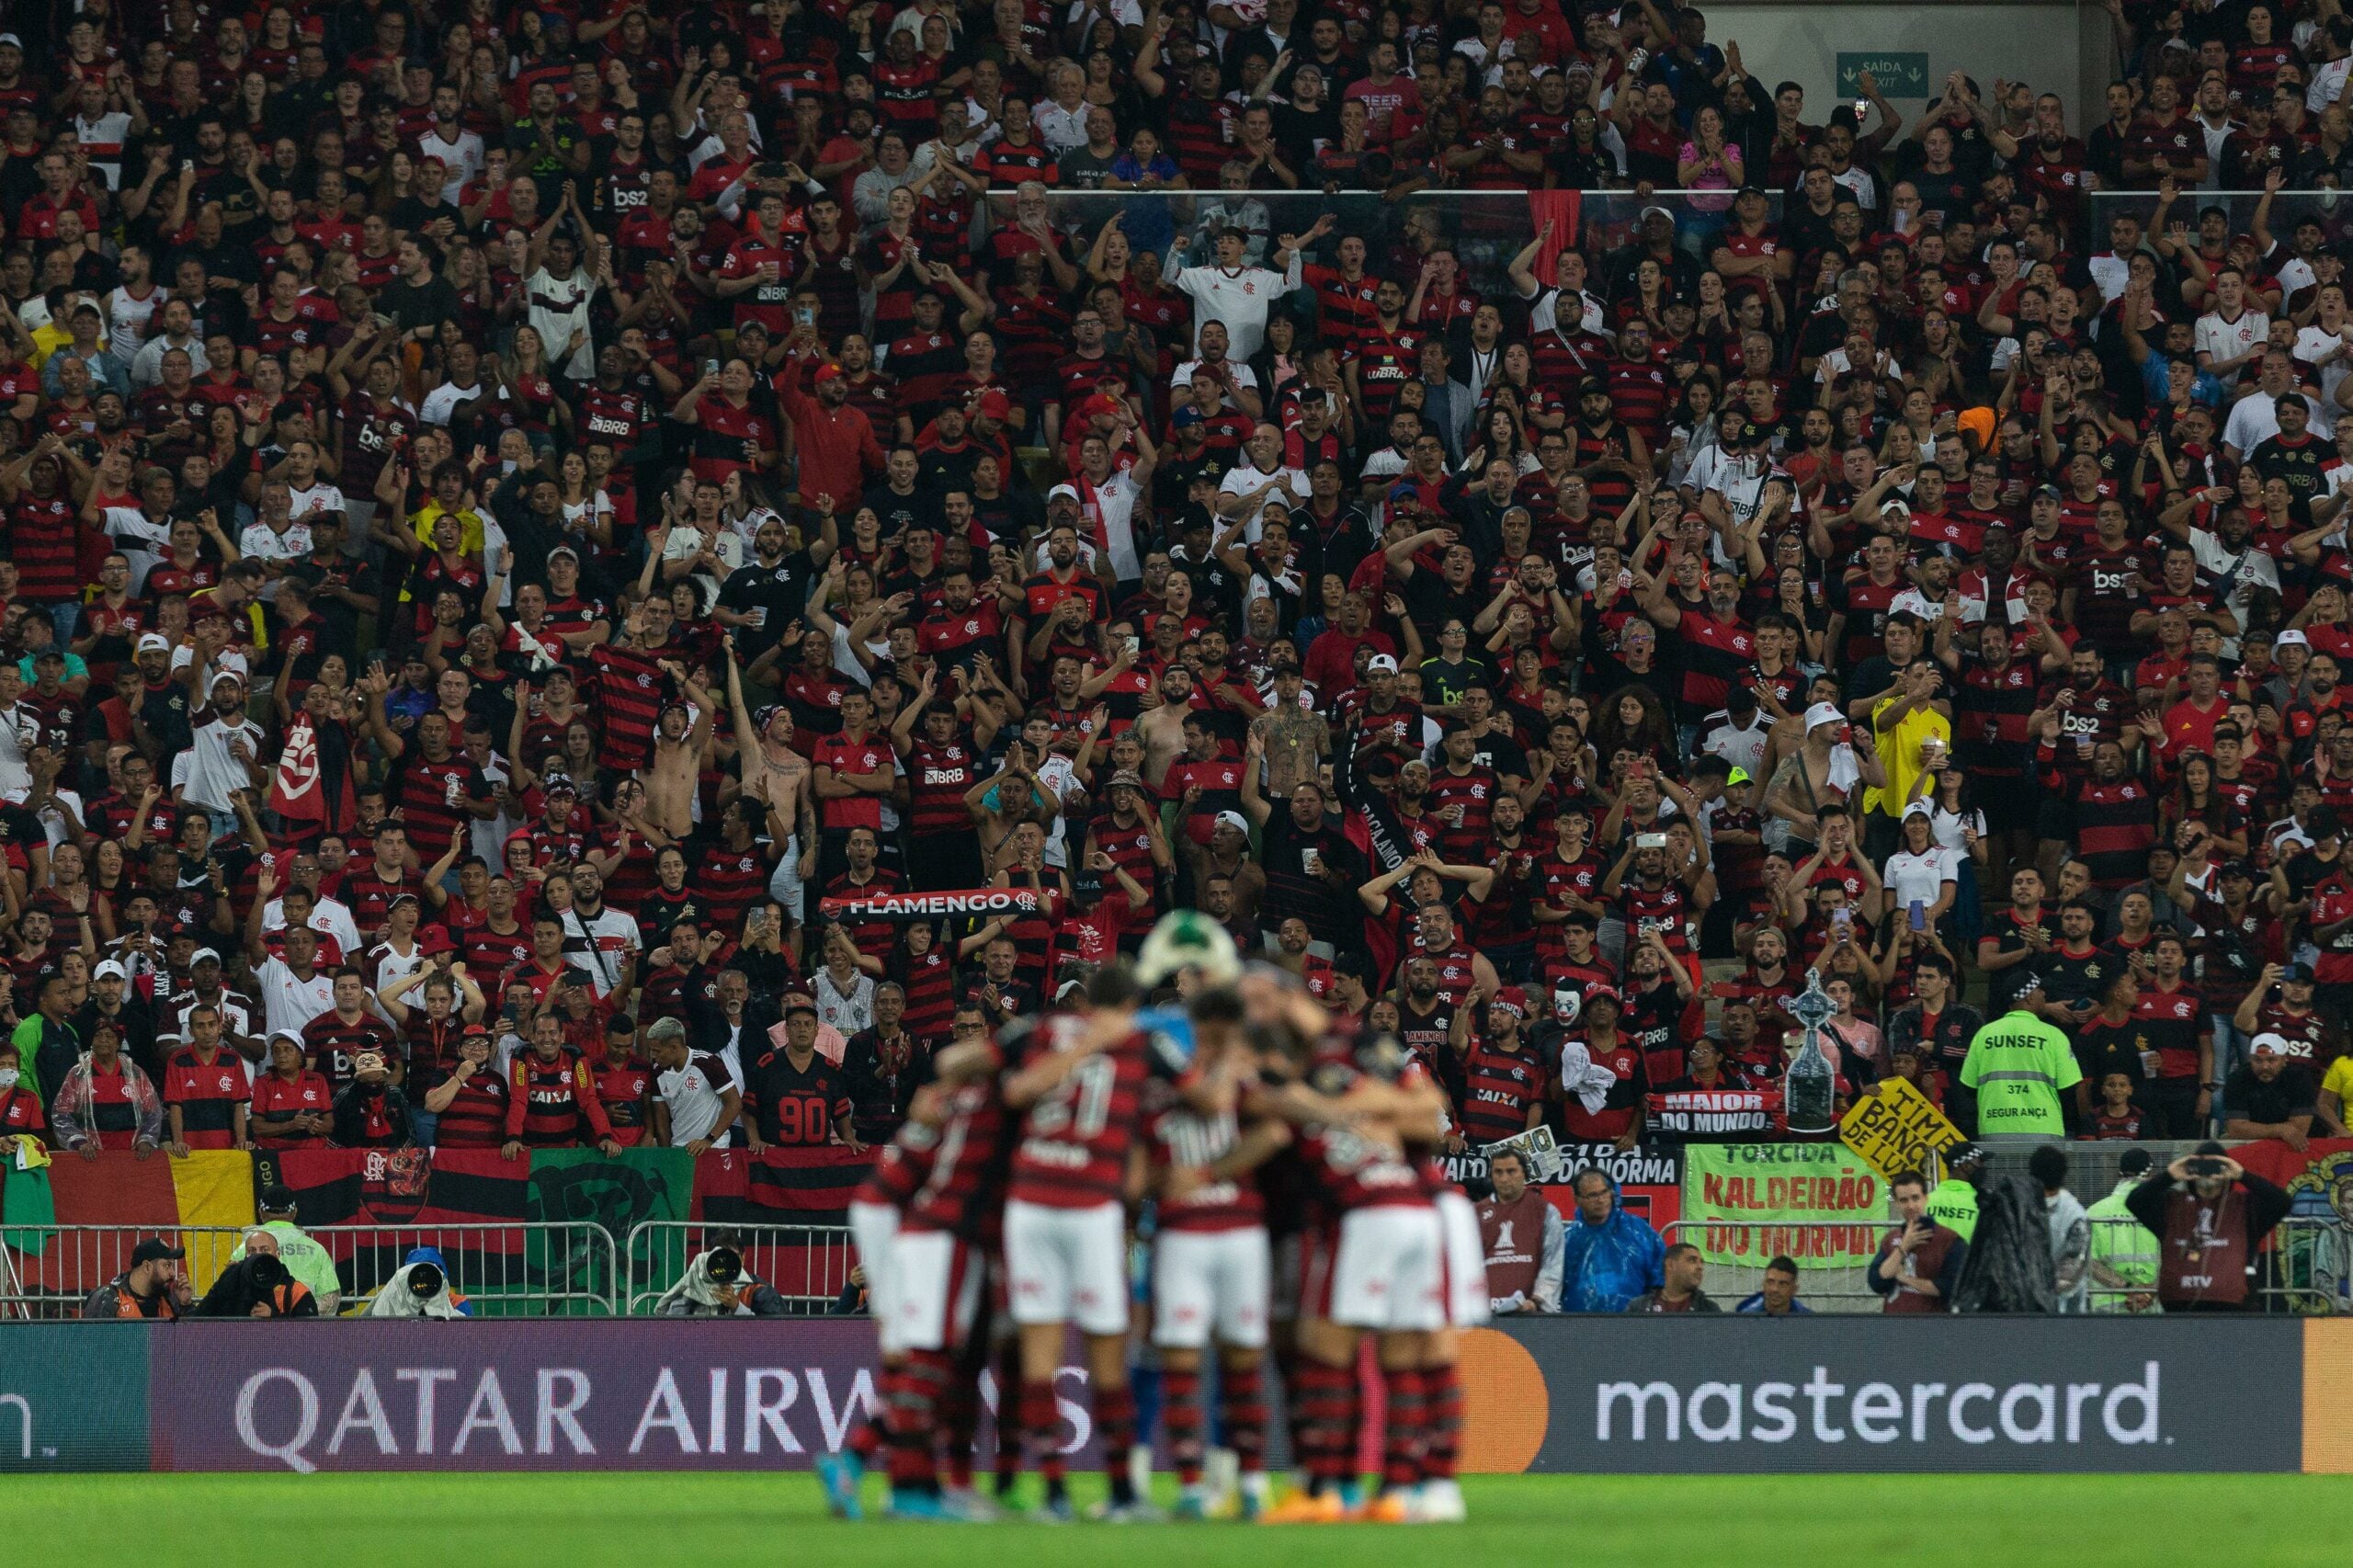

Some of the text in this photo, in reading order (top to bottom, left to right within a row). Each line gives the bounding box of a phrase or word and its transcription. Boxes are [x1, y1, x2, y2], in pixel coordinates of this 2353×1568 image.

[1863, 60, 1901, 74] SAÍDA
[614, 187, 648, 207] bs2
[772, 287, 788, 301] BR
[359, 423, 383, 450] bs
[602, 420, 630, 436] BRB
[2094, 569, 2125, 589] bs
[1442, 686, 1463, 706] bs
[2063, 710, 2099, 733] bs2
[938, 767, 964, 784] BRB
[850, 892, 1010, 915] FLAMENGO
[1644, 1027, 1668, 1046] BRB
[1984, 1035, 2047, 1051] SUNSET
[529, 1090, 571, 1104] CAIXA
[1477, 1088, 1519, 1108] CAIXA
[2007, 1085, 2029, 1096] 374
[1665, 1095, 1763, 1109] MAIOR
[779, 1096, 826, 1143] 90
[1661, 1112, 1766, 1132] DO MUNDO
[1842, 1120, 1873, 1148] DE
[1723, 1142, 1837, 1165] TORCIDA
[1598, 1157, 1676, 1184] NORMA
[1704, 1167, 1874, 1210] KALDEIRÃO
[1927, 1205, 1976, 1221] UNSET
[1706, 1216, 1750, 1255] DO
[2180, 1275, 2212, 1289] RTV
[1597, 1359, 2159, 1444] mastercard
[234, 1367, 1091, 1474] QATAR AIRWS
